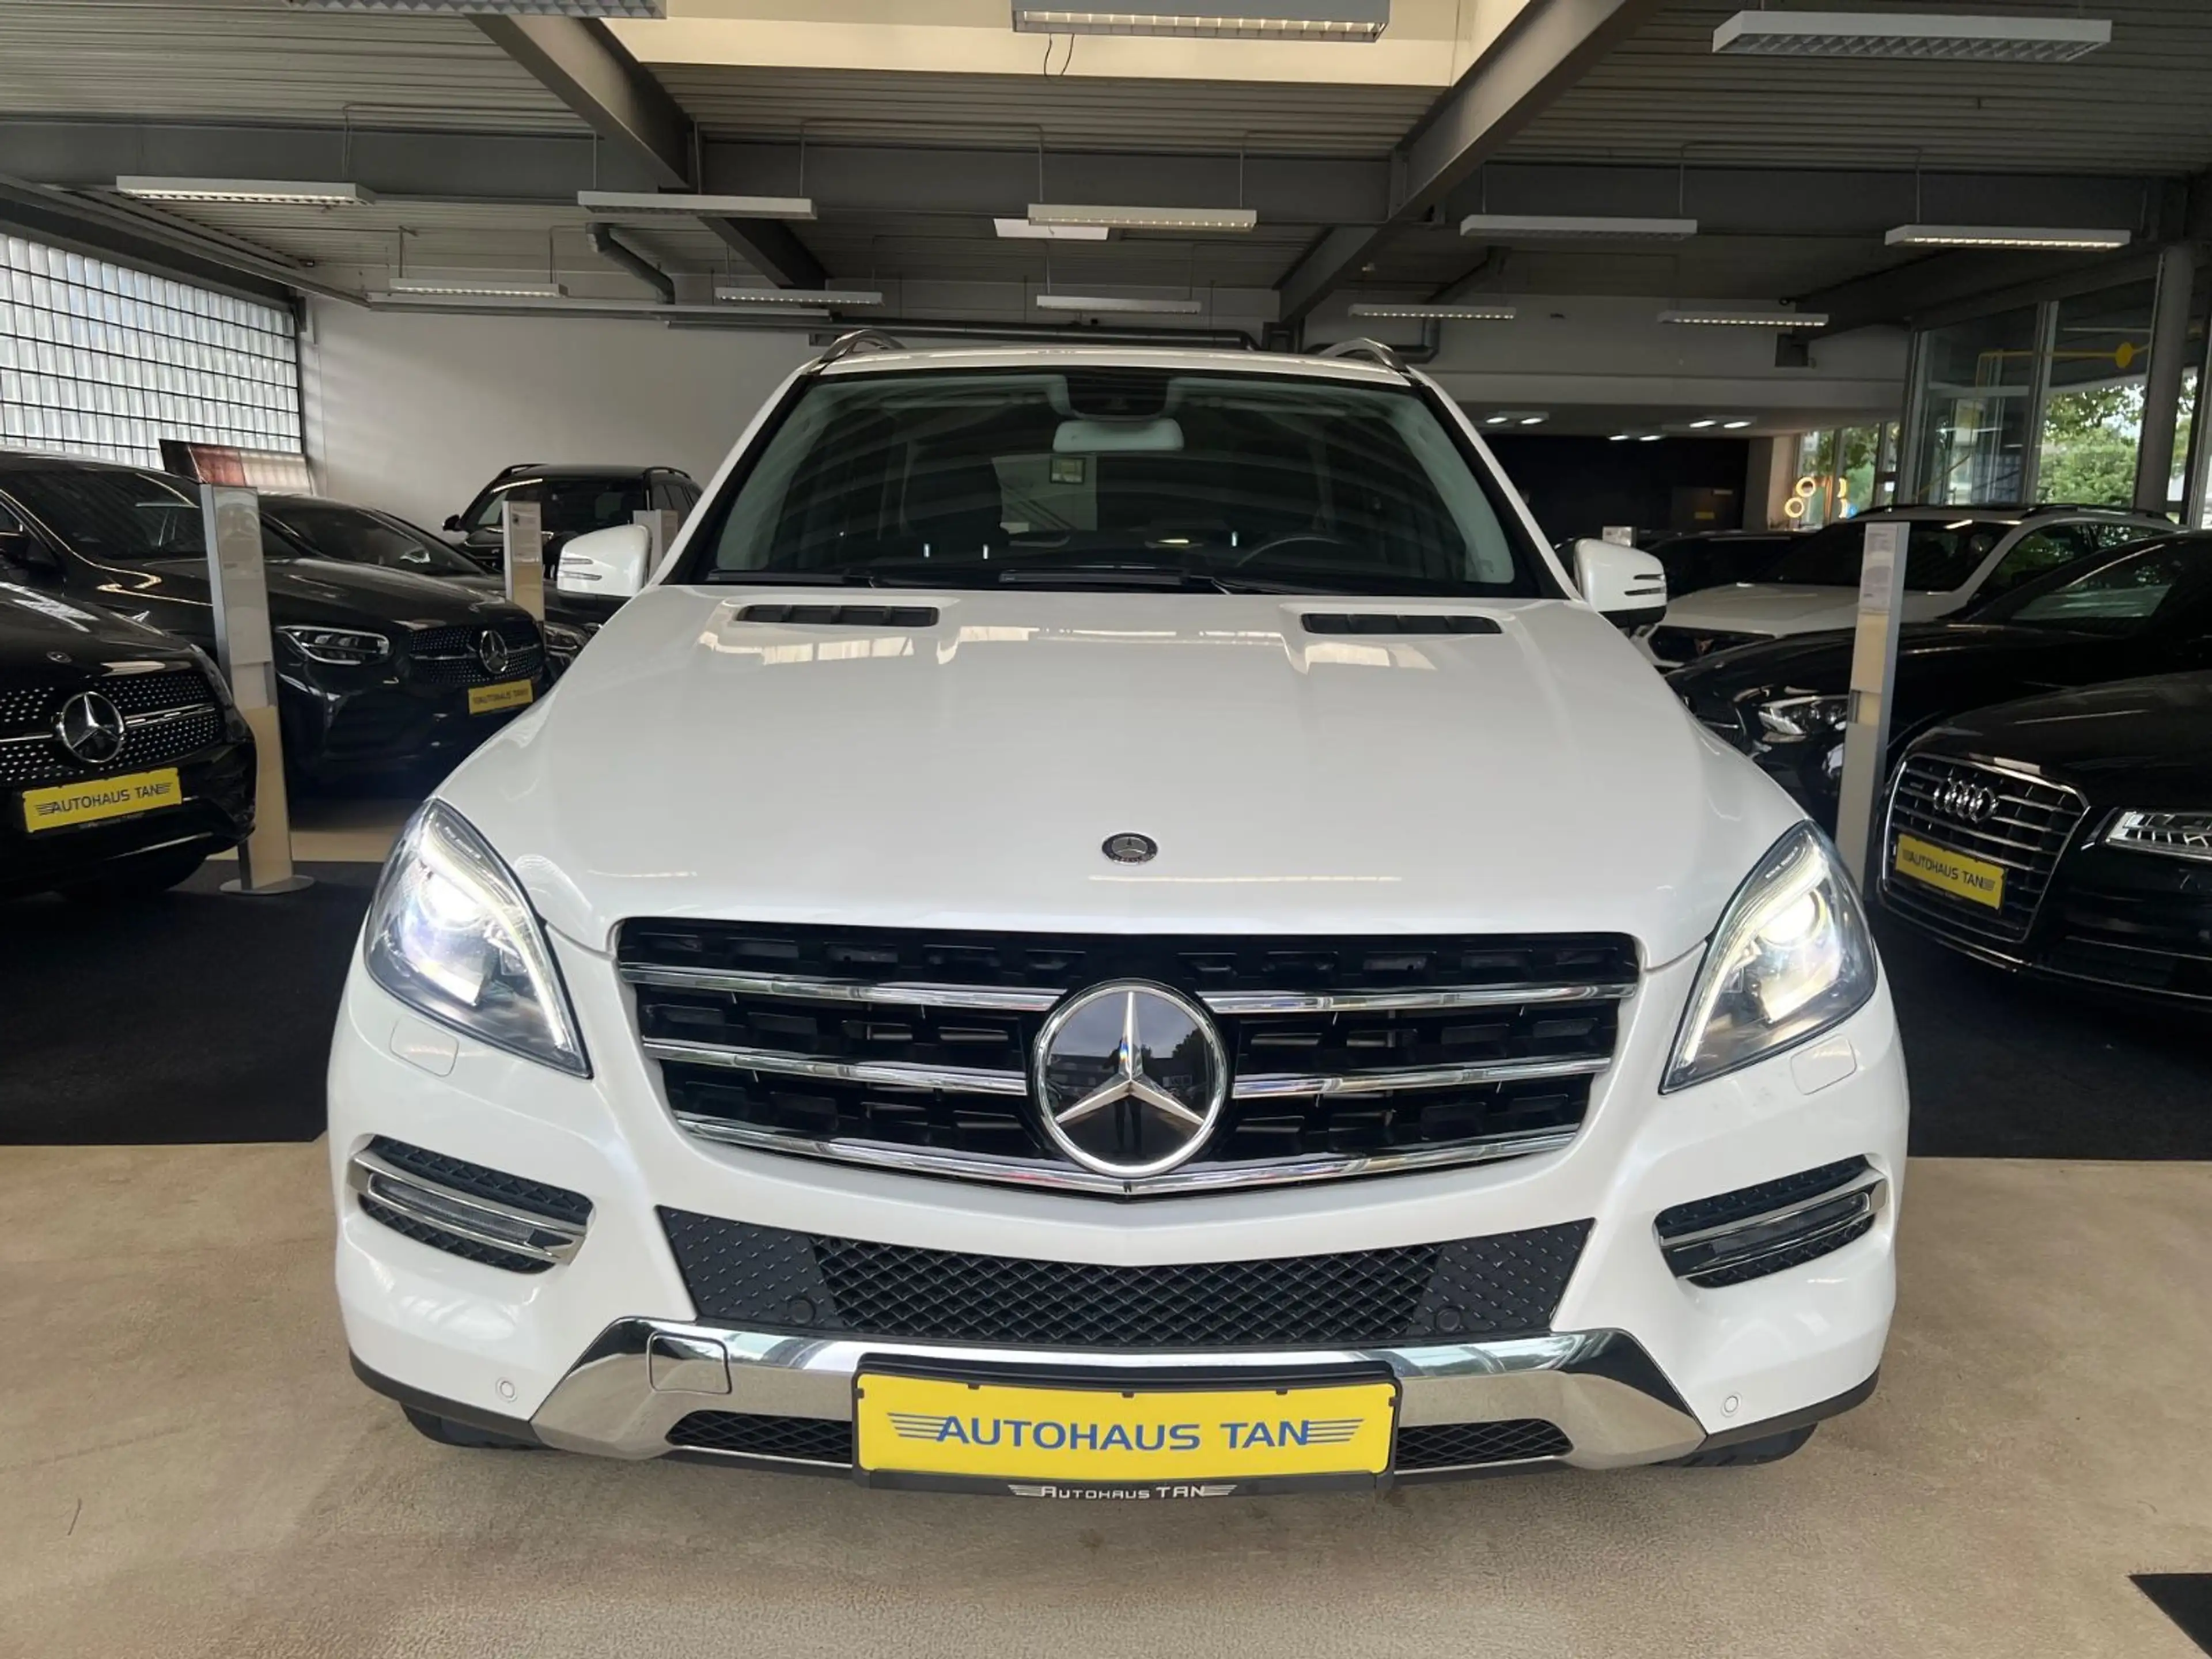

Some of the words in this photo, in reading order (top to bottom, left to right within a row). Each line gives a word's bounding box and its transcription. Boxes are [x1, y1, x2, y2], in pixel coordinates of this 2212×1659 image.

[52, 789, 131, 813] AUTOHAUS
[135, 783, 162, 799] TAN
[1908, 851, 1959, 881] AUTOHAUS
[1961, 870, 1984, 888] TAN
[937, 1415, 1201, 1451] AUTOHAUS
[1219, 1419, 1310, 1449] TAN
[1041, 1486, 1150, 1499] AUTOHAUS
[1156, 1485, 1206, 1498] TAN
